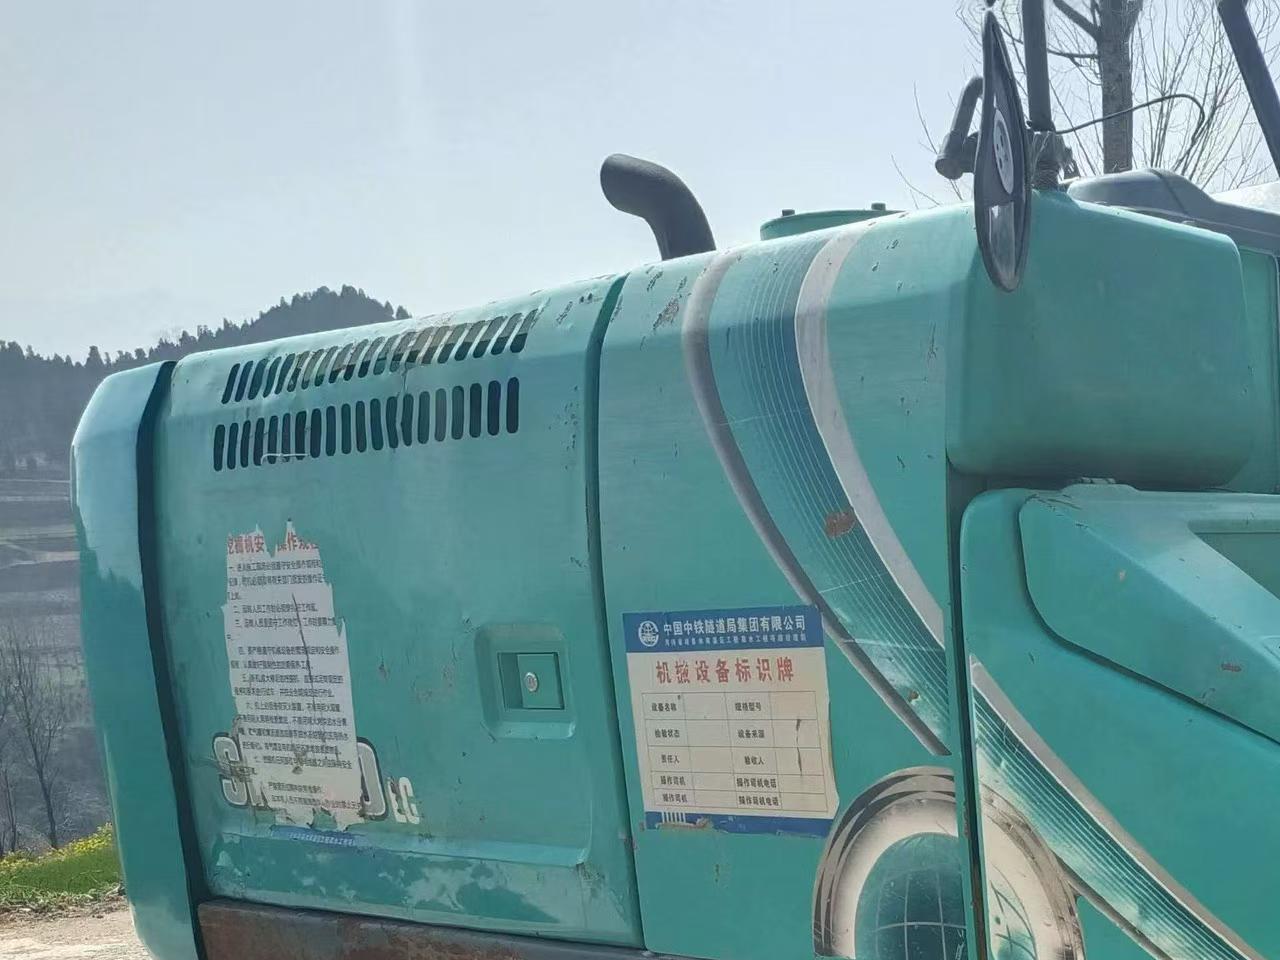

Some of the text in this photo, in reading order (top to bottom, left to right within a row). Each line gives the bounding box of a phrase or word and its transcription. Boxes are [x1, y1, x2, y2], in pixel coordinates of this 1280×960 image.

[663, 614, 806, 636] 中国中铁隧道局集团有限公司
[655, 656, 795, 684] 机械设备标识牌
